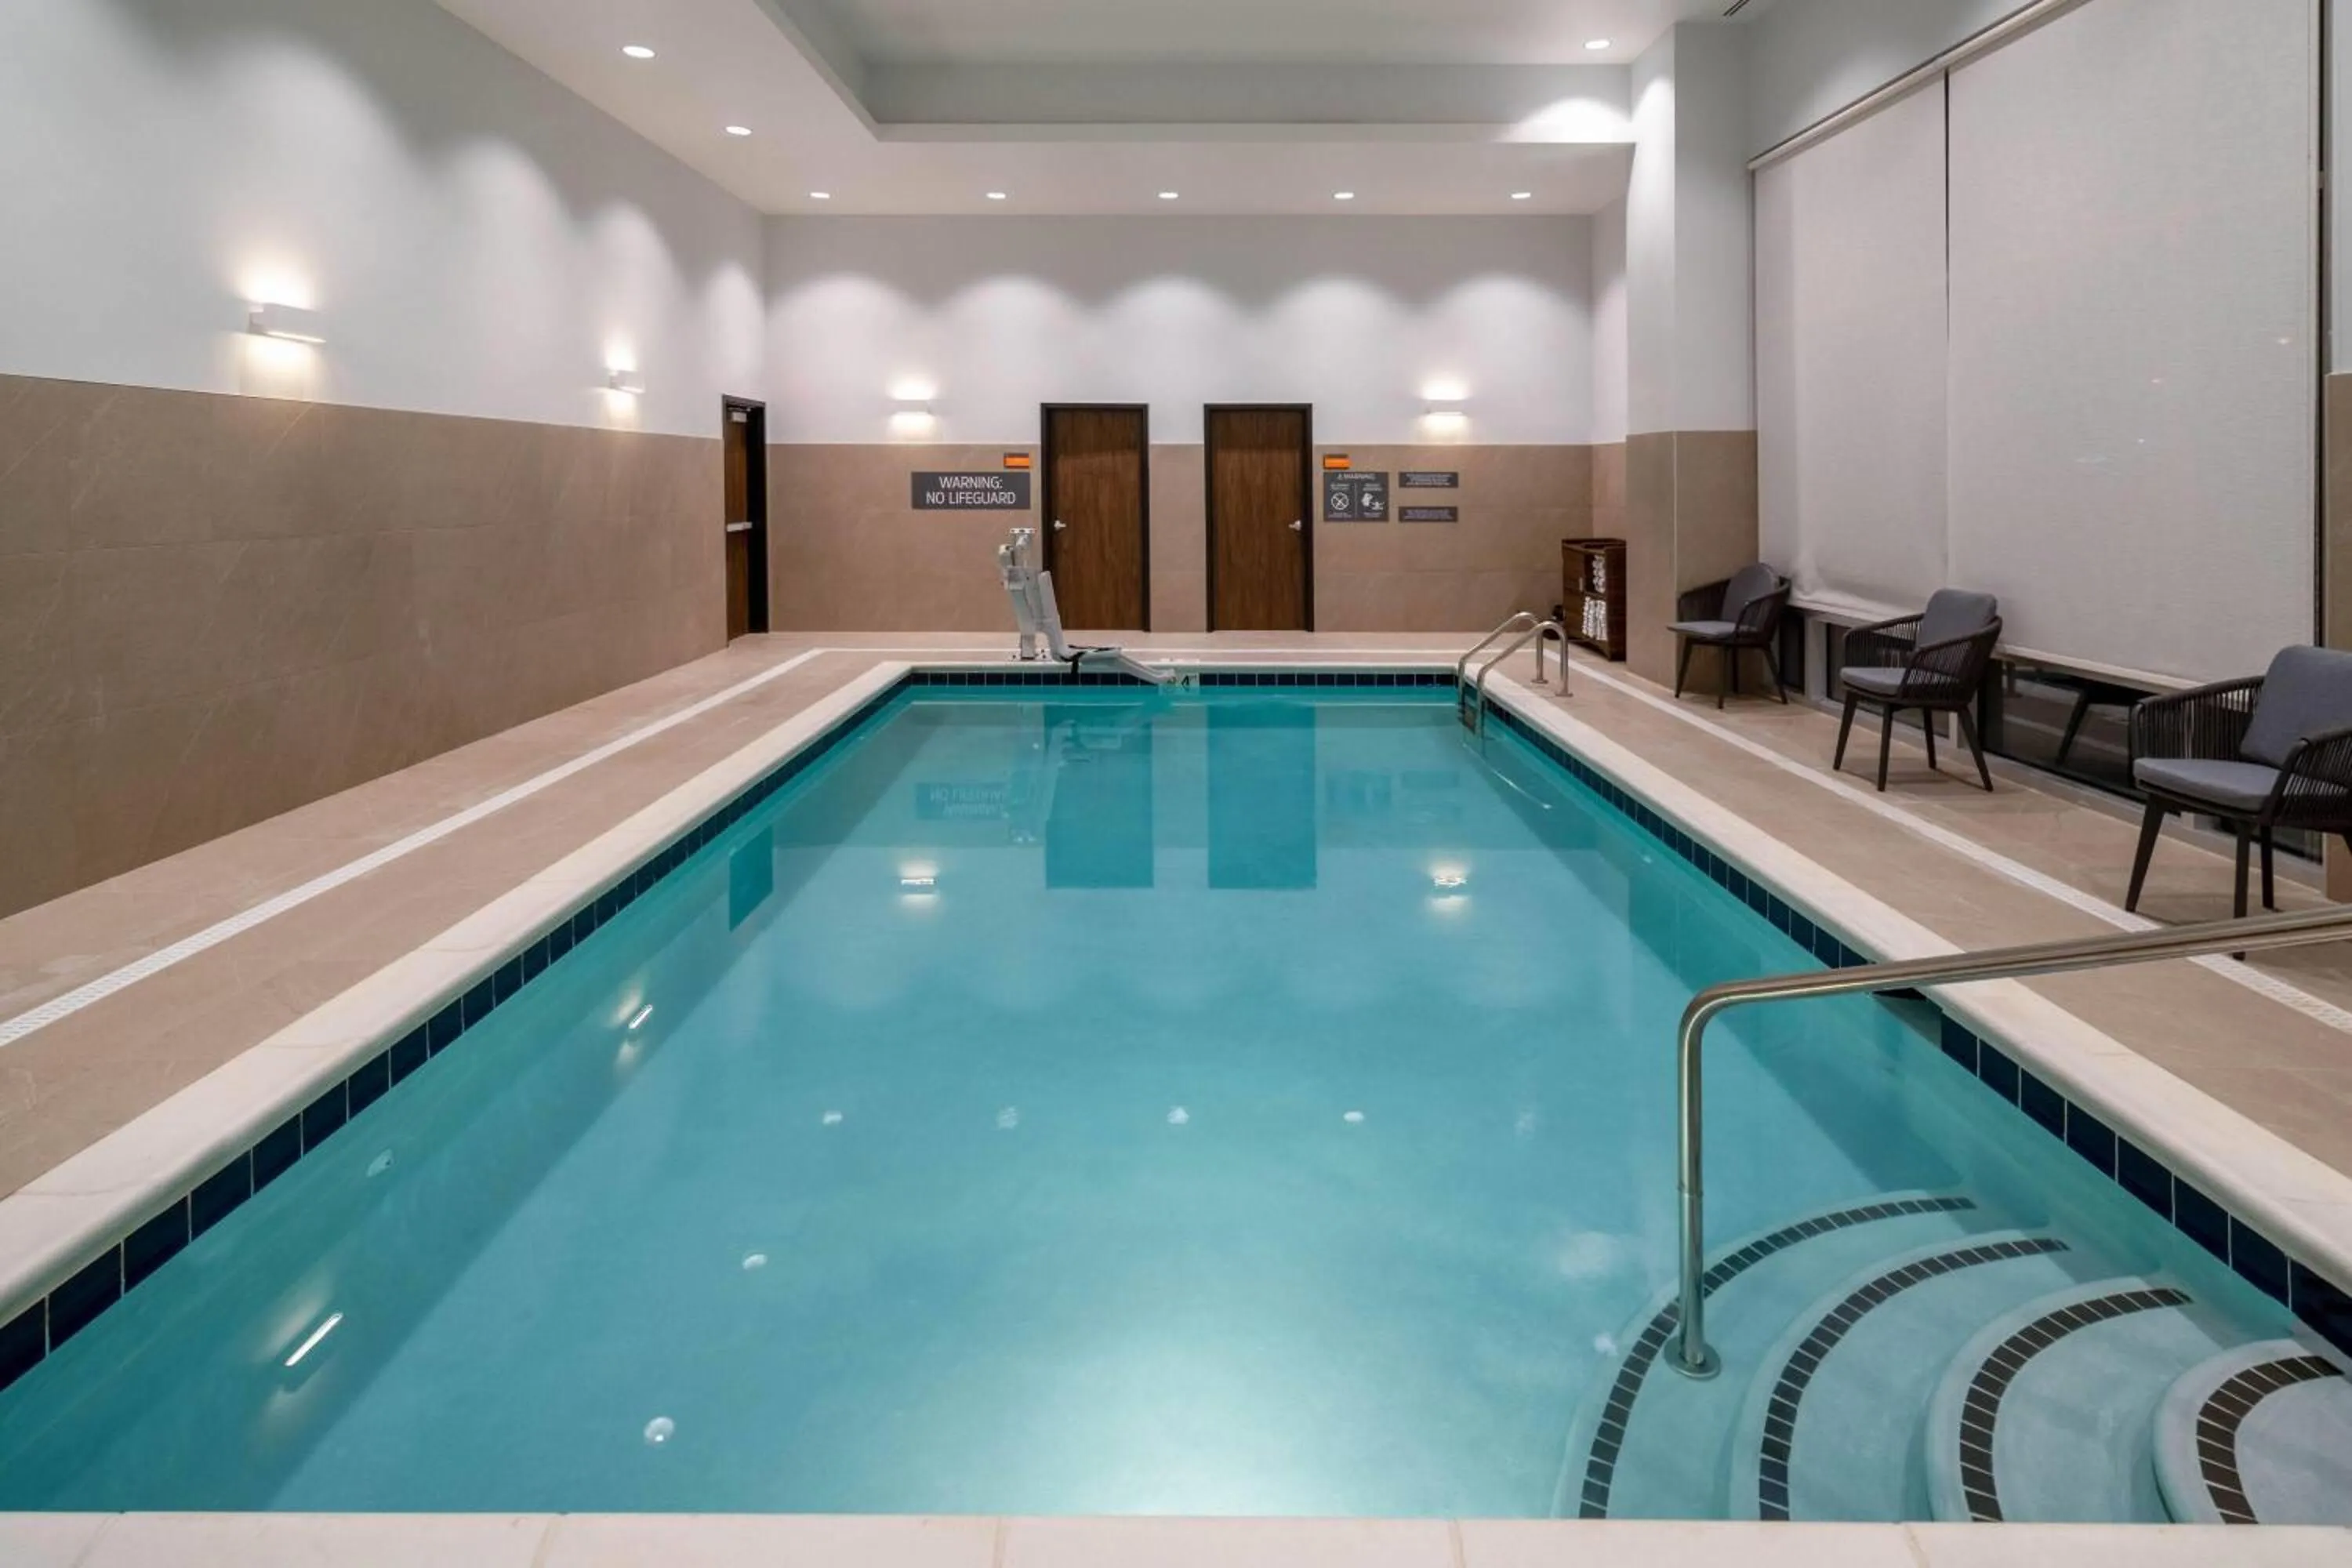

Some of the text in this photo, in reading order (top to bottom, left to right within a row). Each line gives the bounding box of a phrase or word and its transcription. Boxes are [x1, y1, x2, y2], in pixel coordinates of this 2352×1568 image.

[938, 476, 1004, 489] WARNING:
[926, 492, 1017, 504] NO LIFEGUARD
